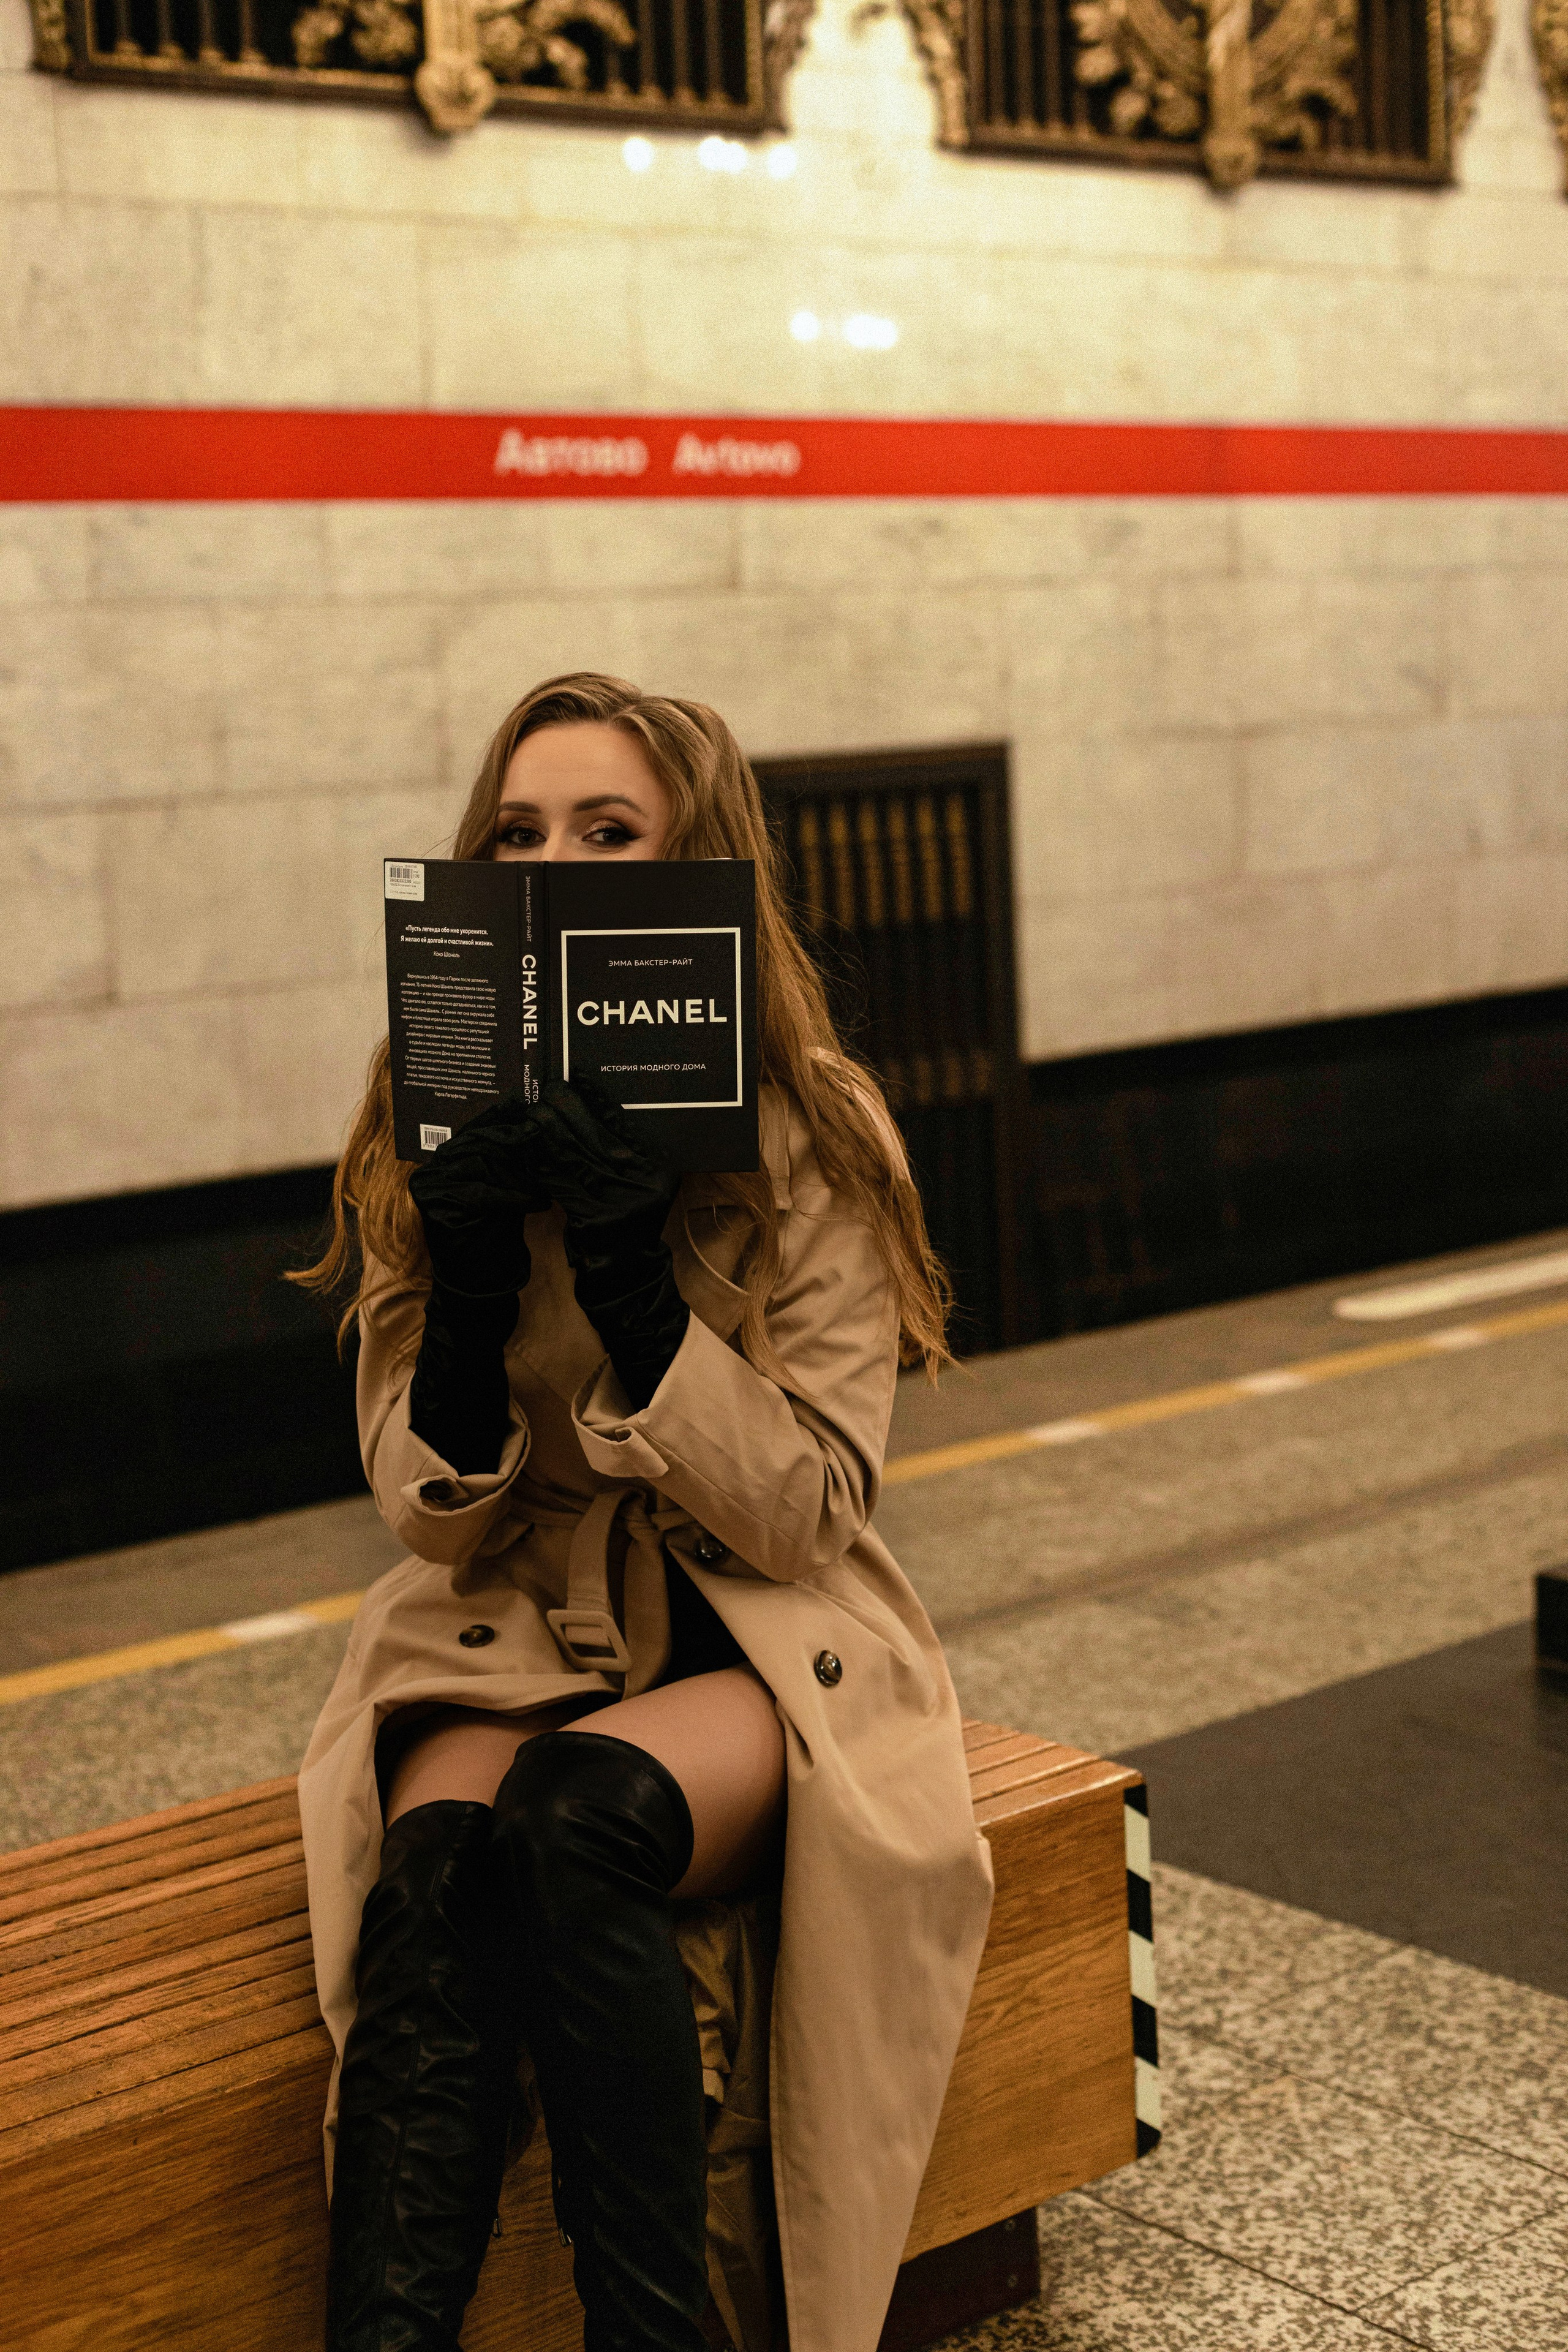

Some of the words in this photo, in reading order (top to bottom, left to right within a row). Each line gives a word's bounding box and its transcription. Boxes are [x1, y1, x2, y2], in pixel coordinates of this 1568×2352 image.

[494, 428, 648, 476] Автово
[673, 432, 801, 477] Avtovo
[522, 954, 538, 1050] CHANEL
[577, 998, 728, 1026] CHANEL
